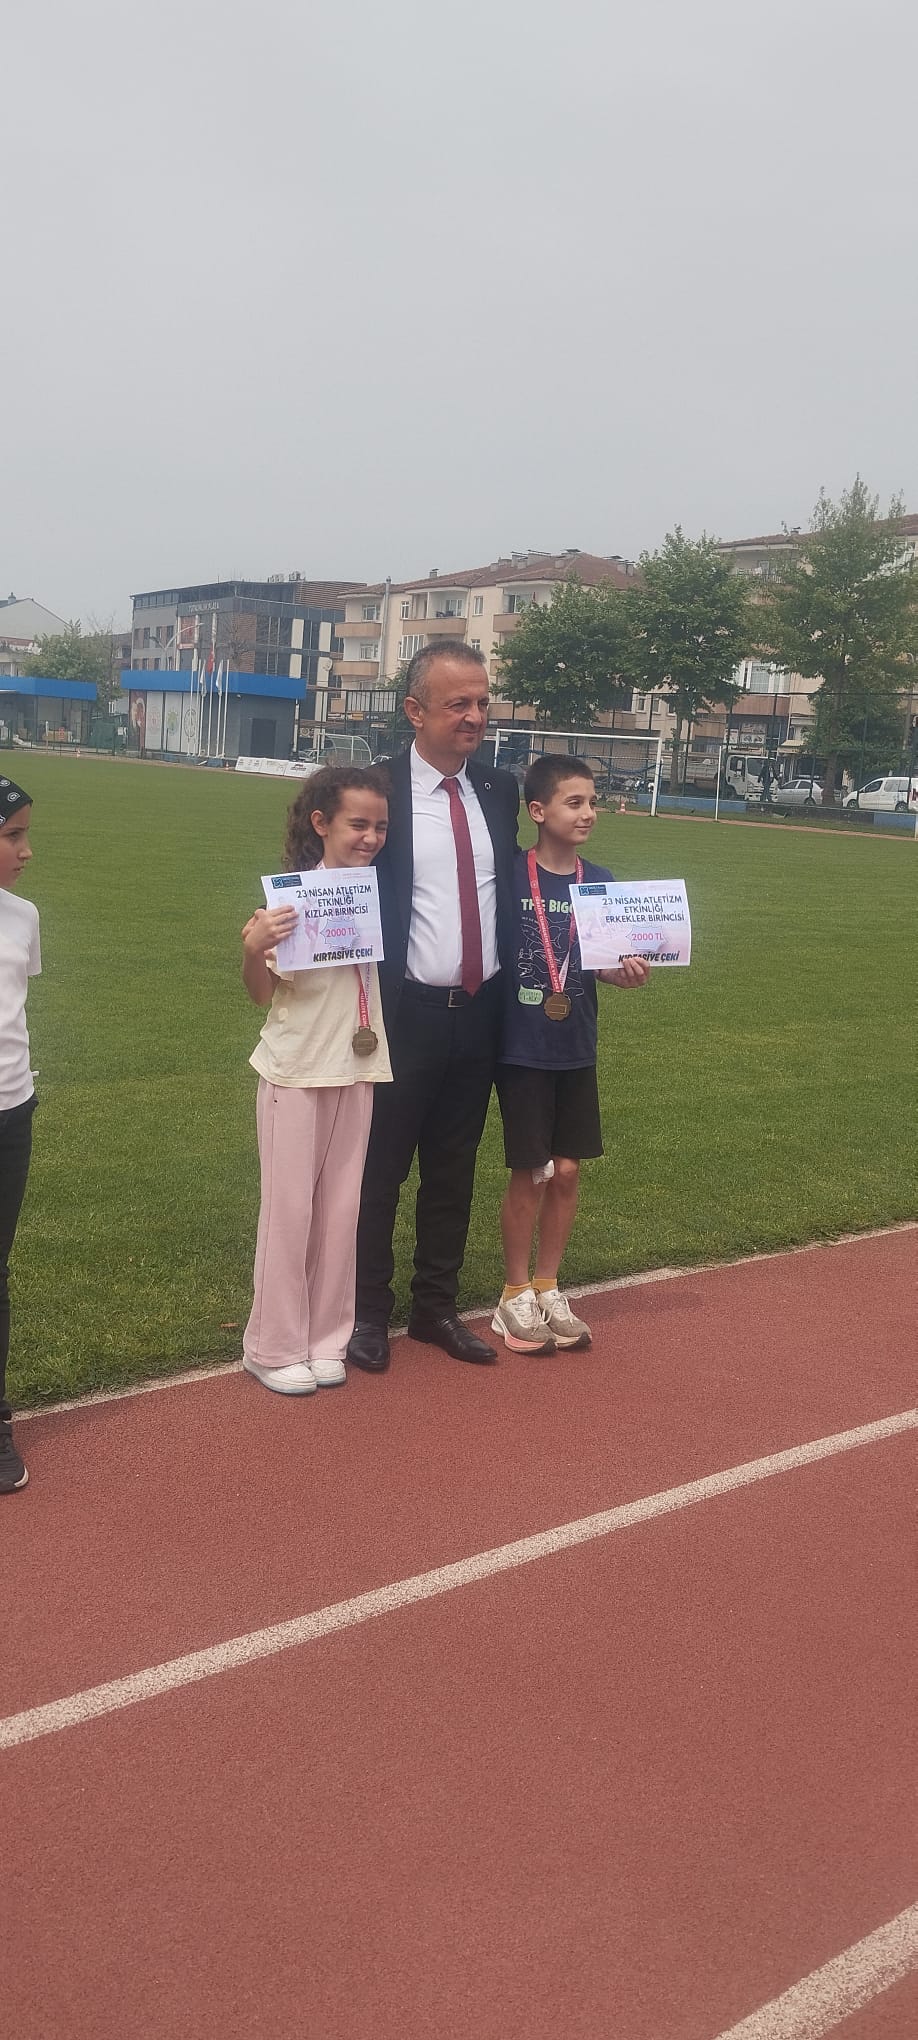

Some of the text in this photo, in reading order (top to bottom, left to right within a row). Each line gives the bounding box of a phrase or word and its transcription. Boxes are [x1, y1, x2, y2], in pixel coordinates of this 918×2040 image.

[296, 883, 372, 898] 23 NİSAN ATLETİZM
[317, 895, 355, 908] ETKİNLİĞİ
[602, 892, 682, 905] 23 NİSAN ATLETİZM
[304, 903, 369, 919] KIZLAR BİRİNCİSİ
[623, 904, 664, 913] ETKİNLİĞİ
[605, 910, 685, 923] ERKEKLER BİRİNCİSİ
[325, 927, 356, 938] 2000 TL
[631, 932, 664, 941] 2000 TL
[313, 944, 373, 962] KIRTASİYE ÇEKİ
[660, 950, 680, 963] ÇEKİ
